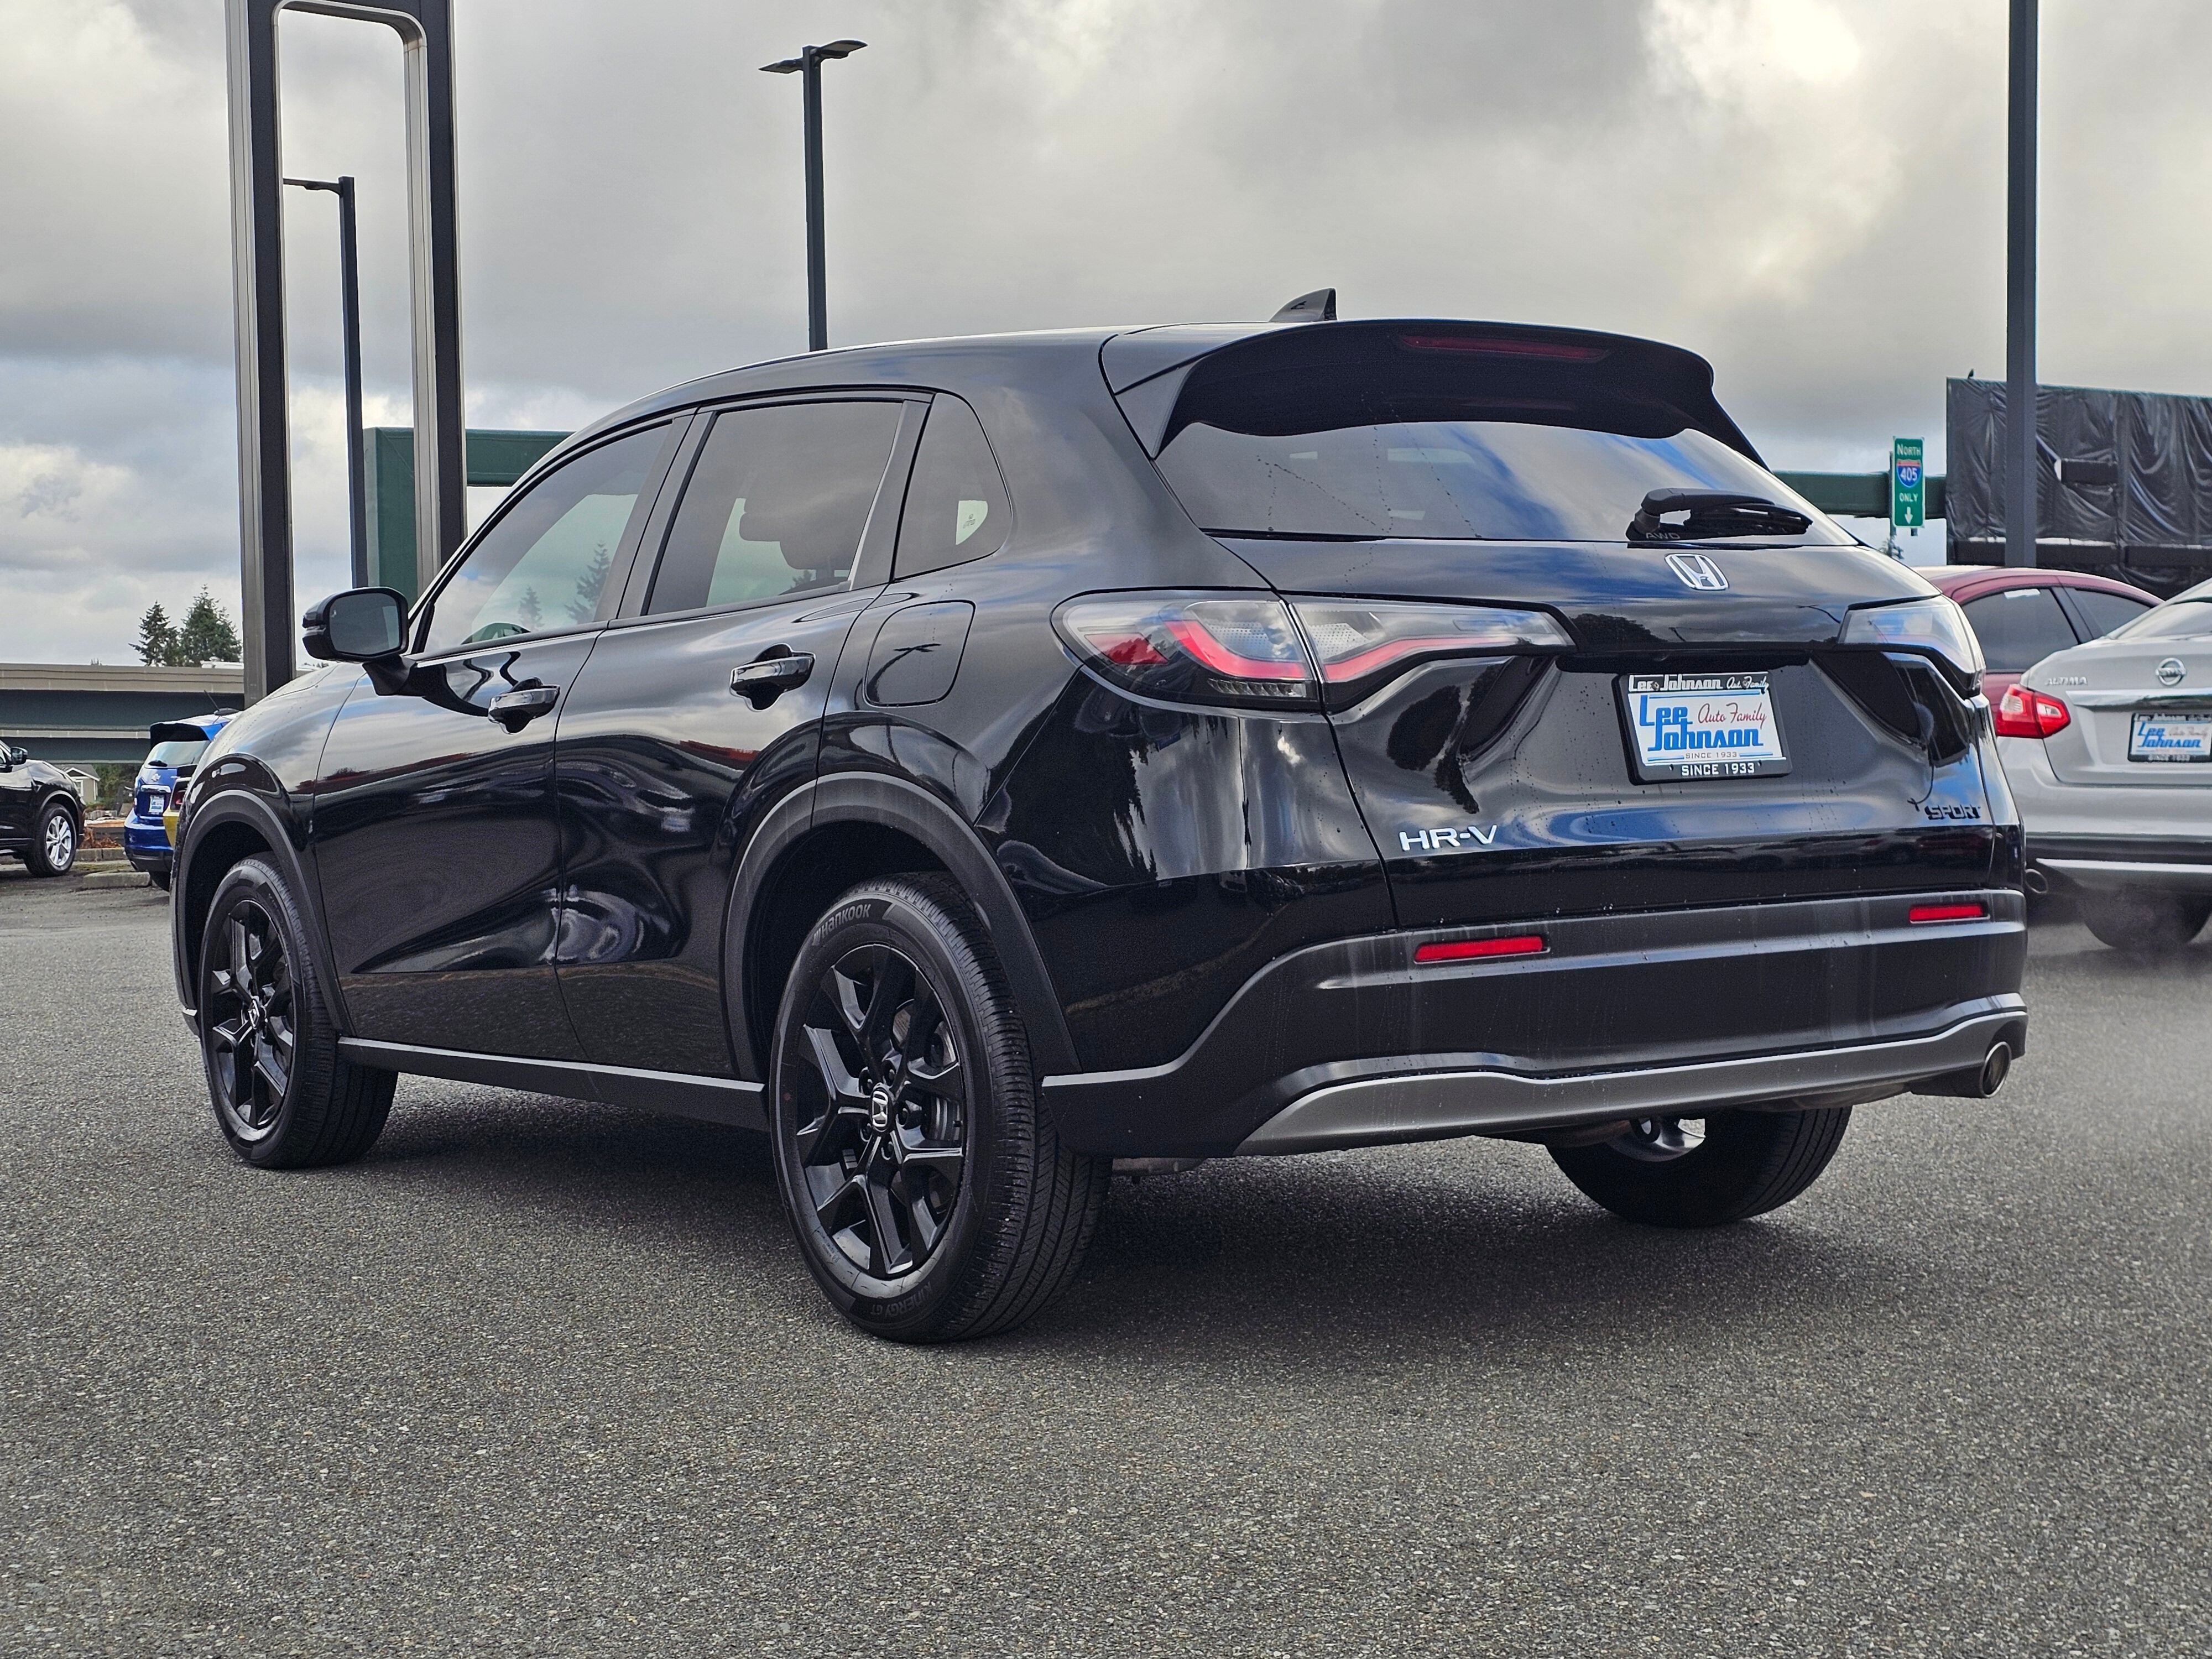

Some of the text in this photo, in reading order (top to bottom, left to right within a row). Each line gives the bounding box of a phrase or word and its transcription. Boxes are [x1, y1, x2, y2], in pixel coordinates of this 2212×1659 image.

[1897, 444, 1921, 456] NORTH
[1900, 467, 1918, 482] 405
[1899, 492, 1918, 502] ONLY
[1660, 673, 1723, 691] Johnson
[1640, 695, 1766, 729] Lee Auto Family
[1647, 719, 1763, 751] Johnson
[1682, 763, 1755, 776] SINCE 1933
[1924, 805, 1981, 820] SPORT
[1399, 825, 1498, 851] HR-V
